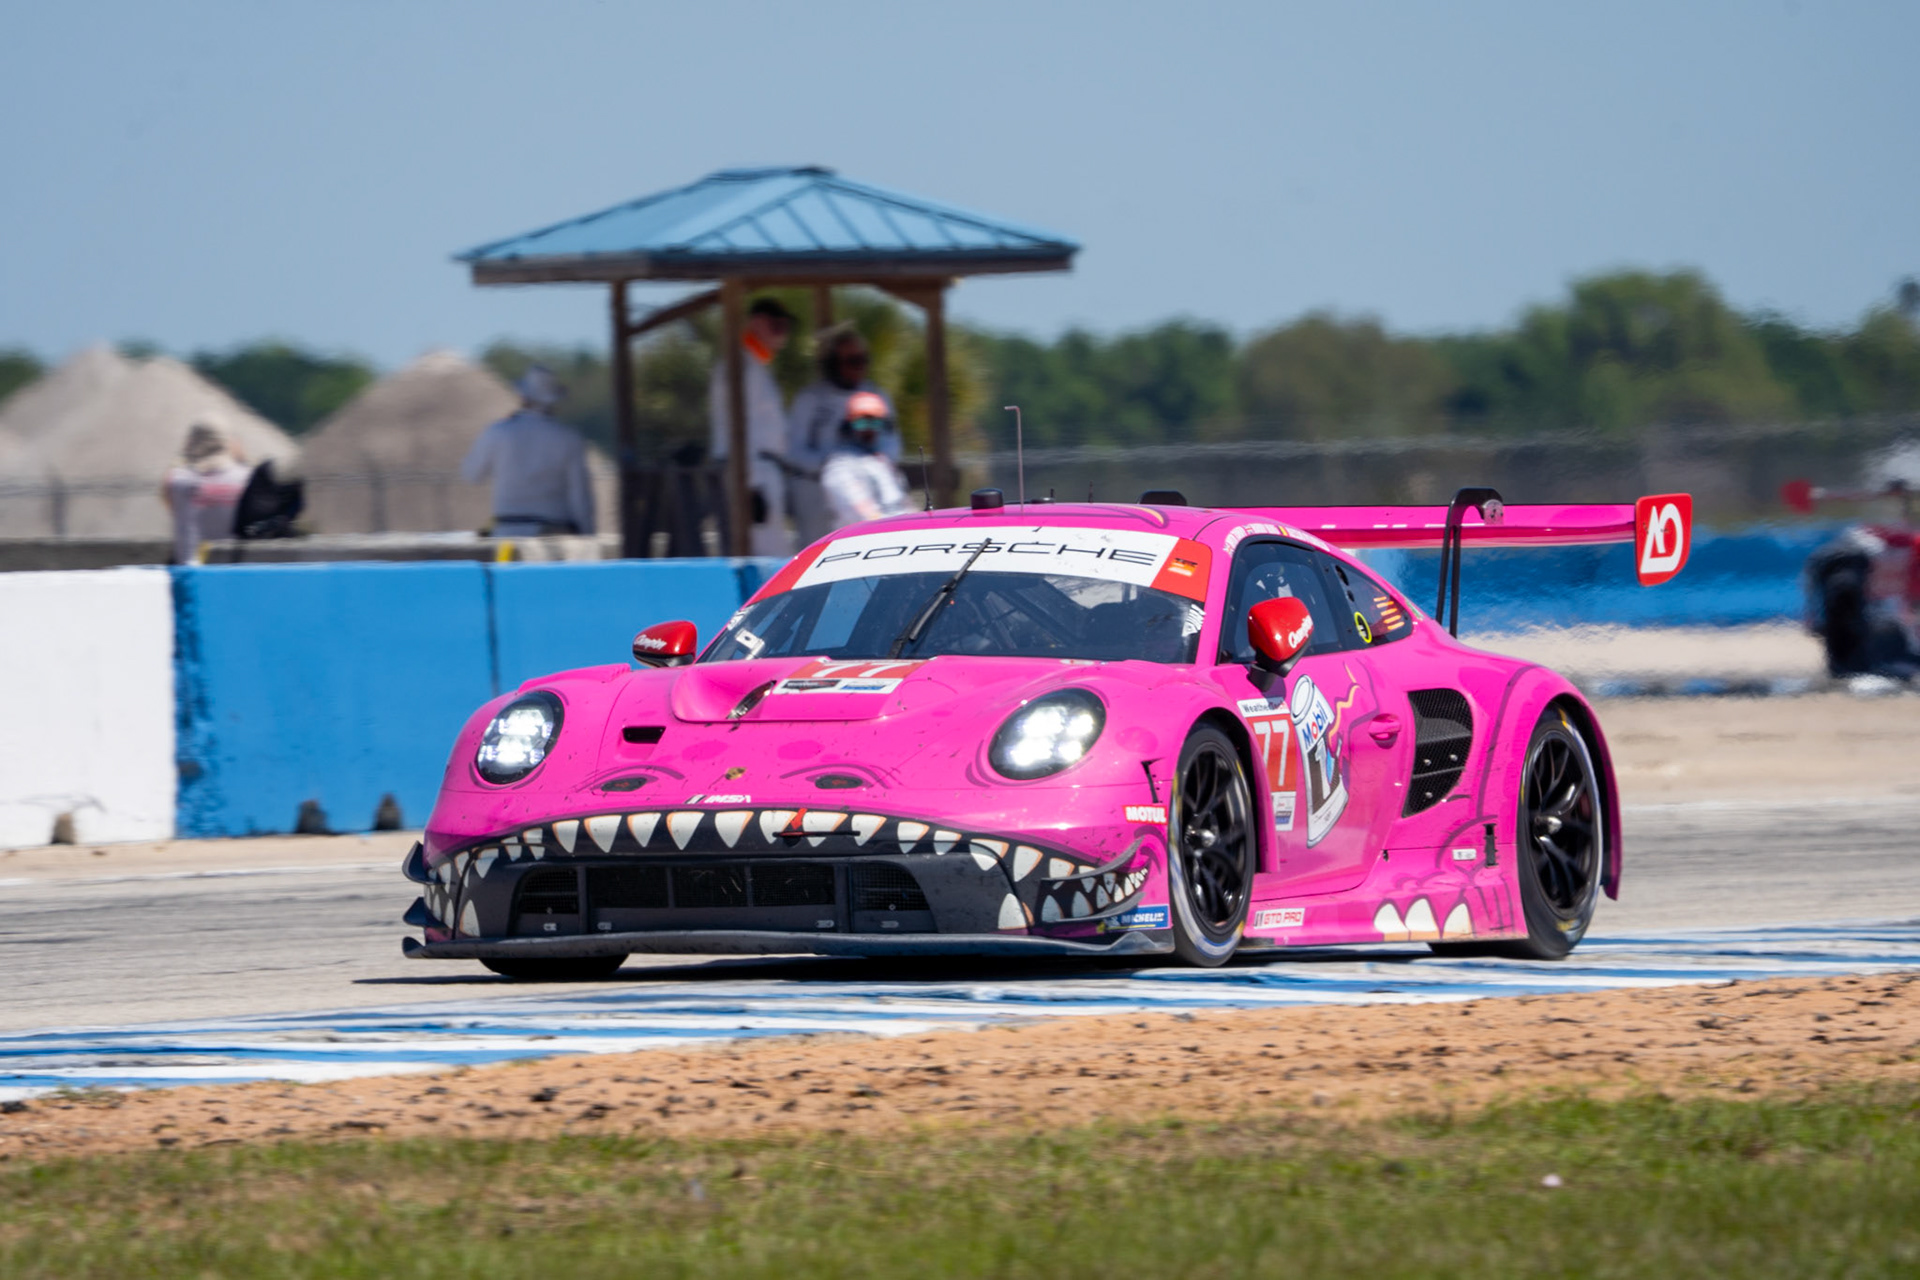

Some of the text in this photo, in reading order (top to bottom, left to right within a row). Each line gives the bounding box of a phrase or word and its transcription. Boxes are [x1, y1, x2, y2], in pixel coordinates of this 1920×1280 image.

[816, 542, 1157, 568] PORSCHE
[812, 662, 913, 677] 77
[1302, 700, 1328, 750] Mobil
[1253, 720, 1290, 787] 77
[1125, 806, 1167, 823] MOTUL
[1121, 912, 1164, 923] MICHELIN
[1263, 911, 1302, 925] GTD PRO
